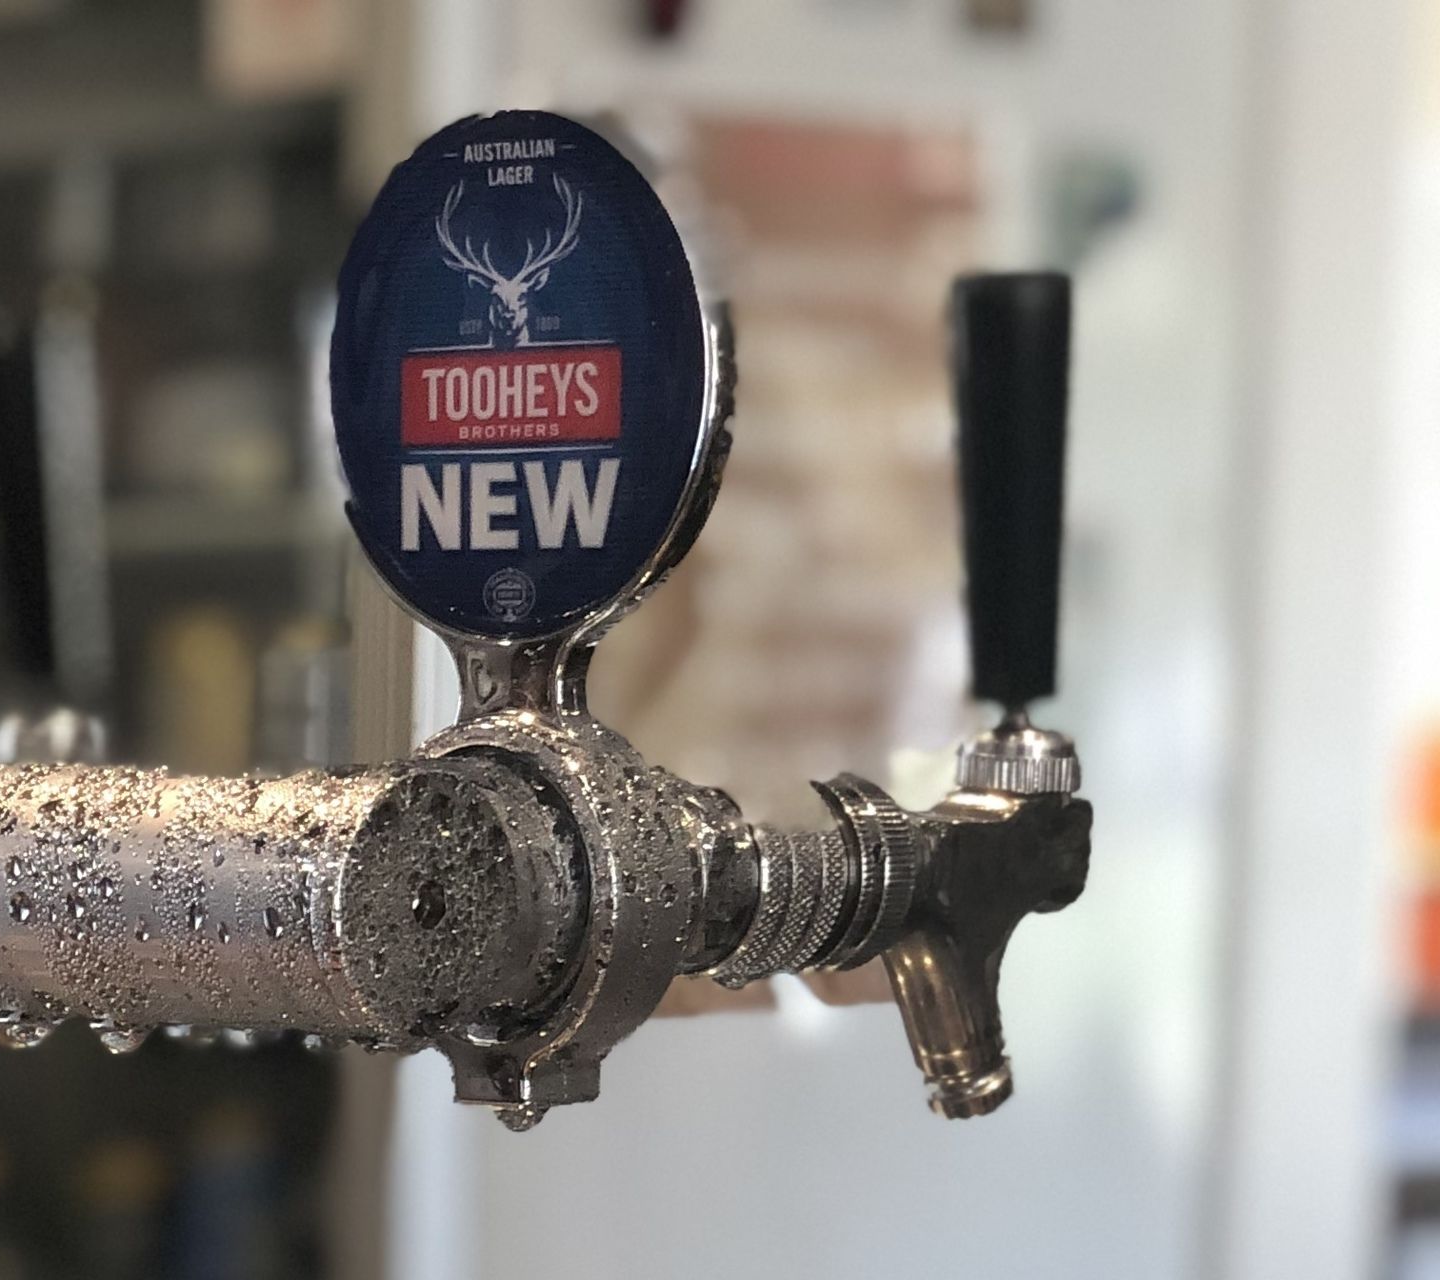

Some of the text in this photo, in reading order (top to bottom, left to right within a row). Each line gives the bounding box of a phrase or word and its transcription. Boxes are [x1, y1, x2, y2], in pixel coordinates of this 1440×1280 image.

[464, 138, 555, 163] AUSTRALIAN
[487, 165, 534, 187] LAGER
[421, 361, 600, 422] TOOHEYS
[458, 422, 561, 440] BROTHERS
[400, 457, 621, 552] NEW
